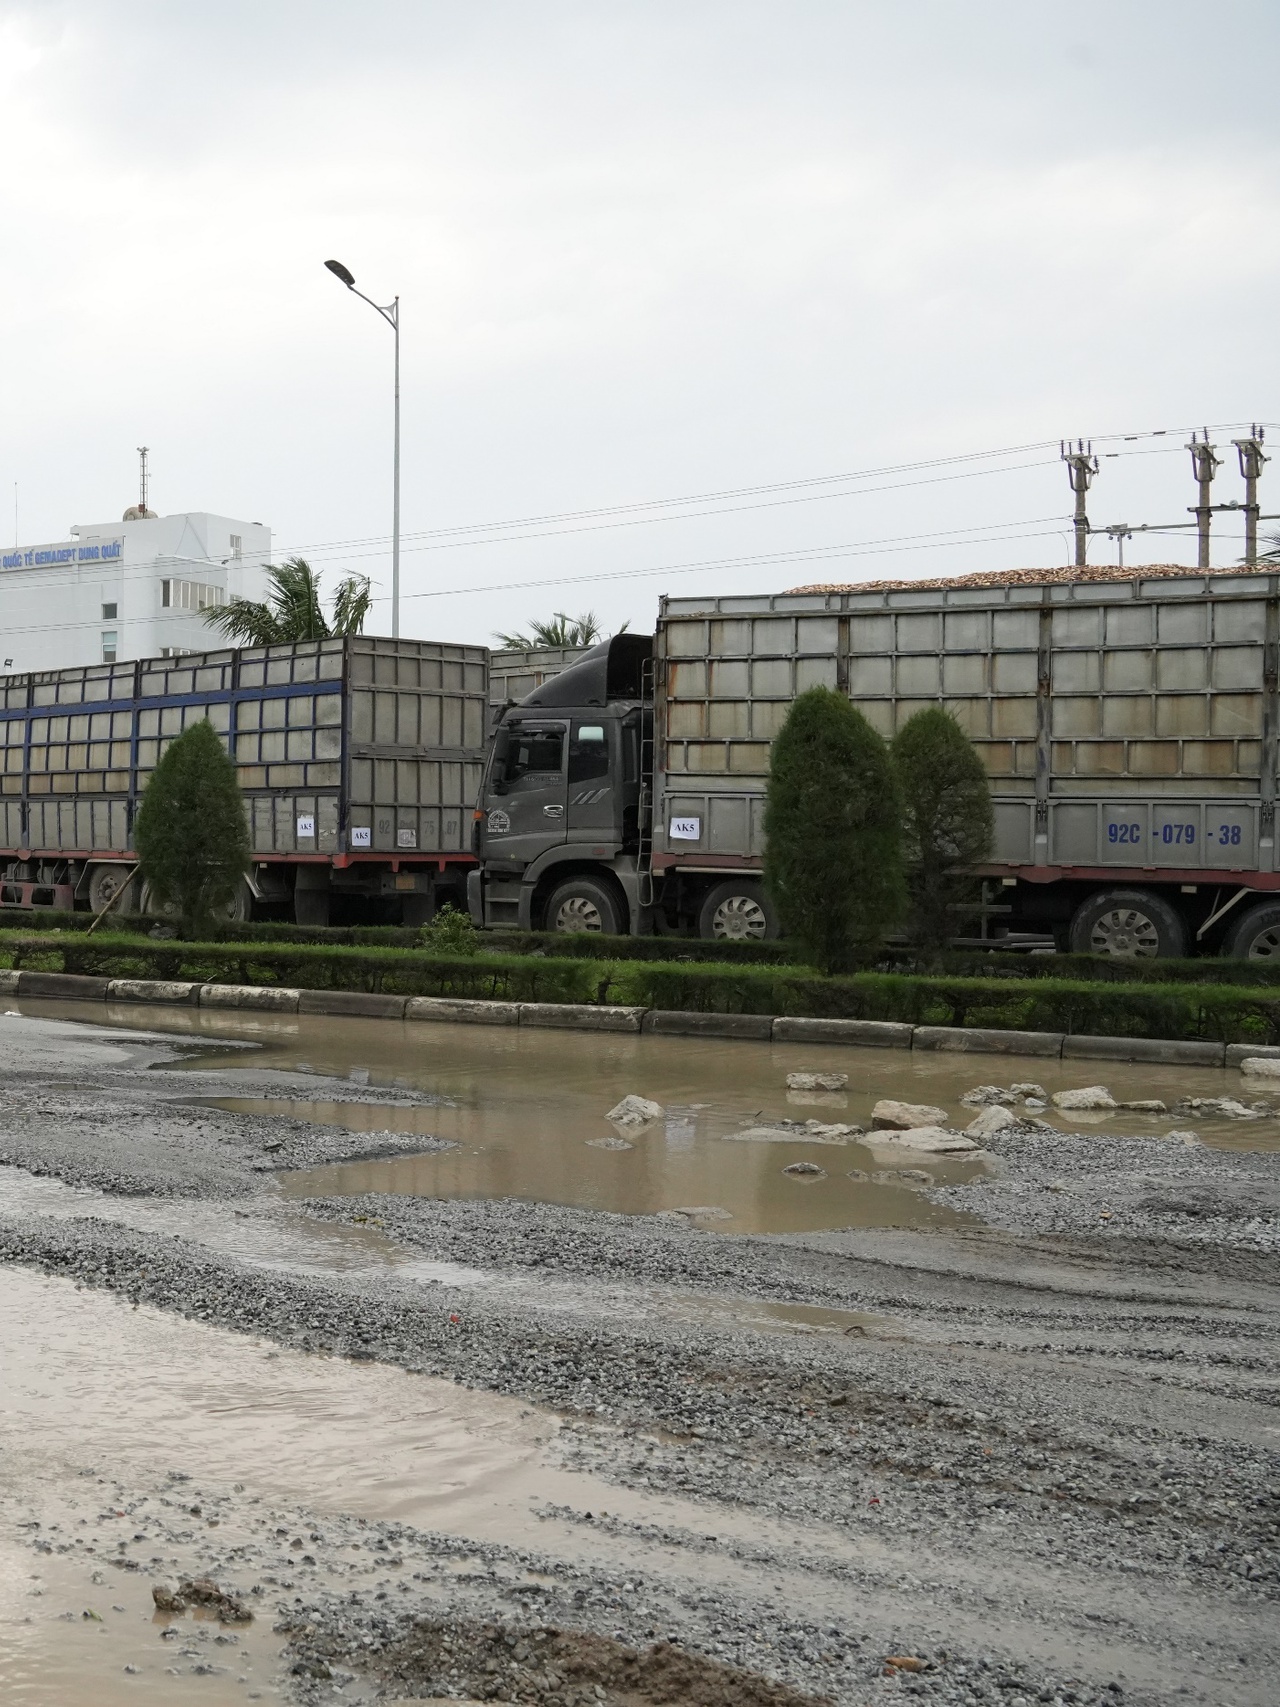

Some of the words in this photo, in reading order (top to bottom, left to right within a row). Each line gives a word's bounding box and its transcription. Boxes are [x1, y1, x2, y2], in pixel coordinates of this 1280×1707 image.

[2, 550, 22, 569] QUỐC
[35, 548, 76, 565] GEMADEPT
[78, 545, 99, 560] DUNG
[674, 823, 695, 832] AK5
[354, 832, 369, 840] AK5
